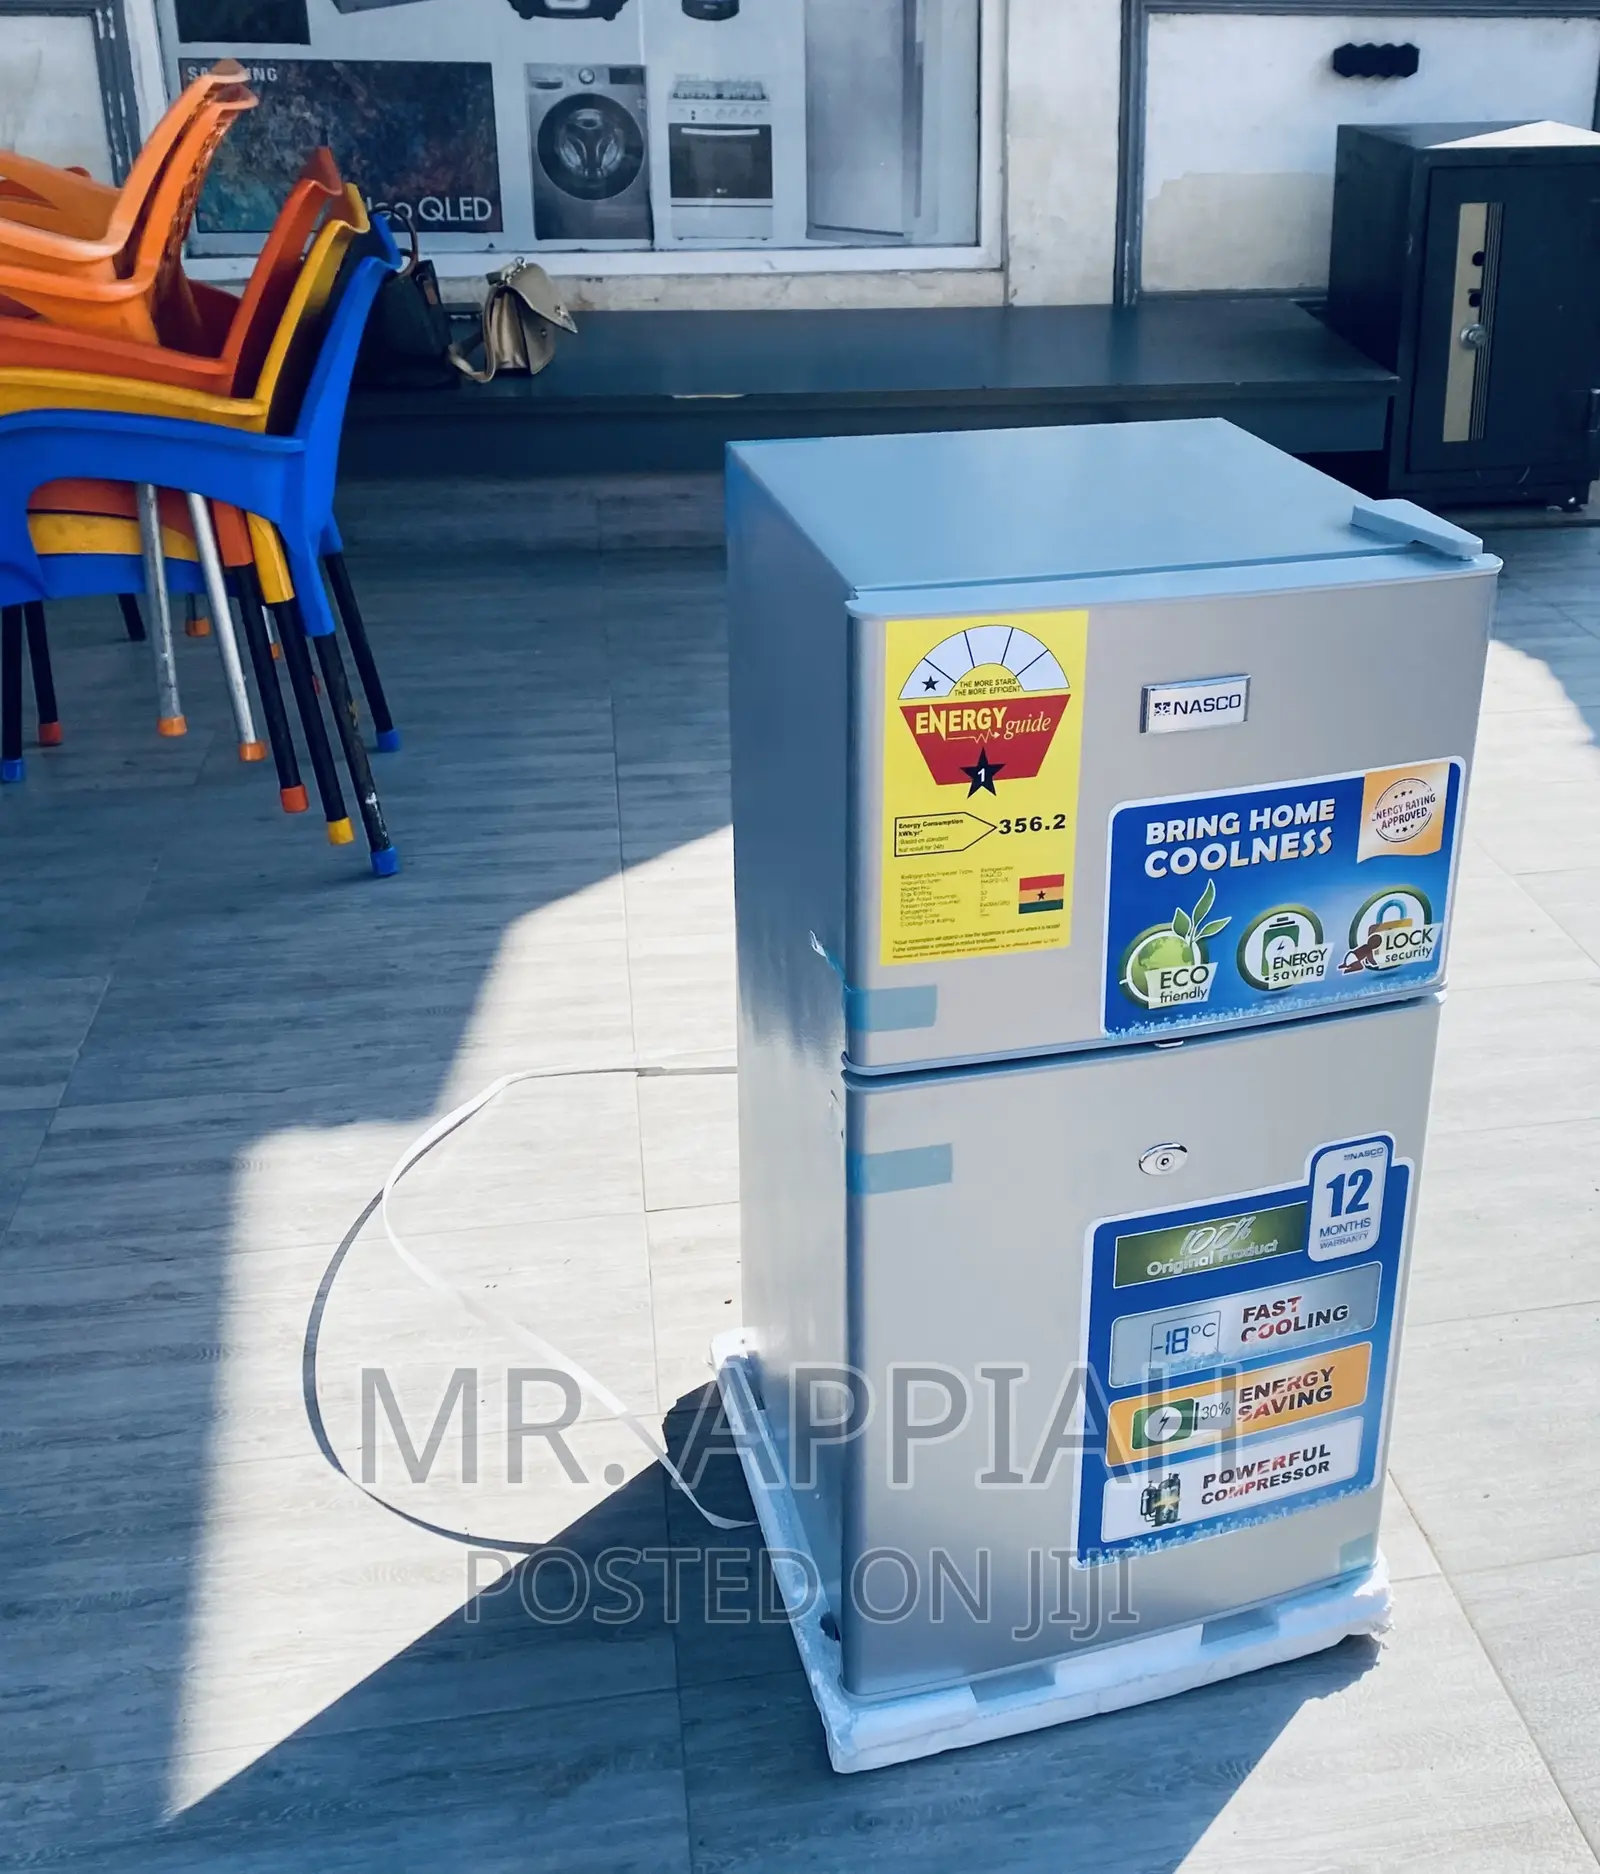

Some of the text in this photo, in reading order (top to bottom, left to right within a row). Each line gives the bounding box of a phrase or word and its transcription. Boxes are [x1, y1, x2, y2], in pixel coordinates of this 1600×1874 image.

[418, 196, 493, 222] QLED
[954, 685, 1021, 696] THE MORE EFFICIENT
[959, 677, 1017, 688] THE MORE STARS
[1174, 694, 1242, 716] NASCO
[916, 705, 1051, 741] ENERGY guide
[977, 768, 986, 783] 1
[1405, 792, 1436, 811] RATING
[998, 814, 1067, 834] 356.2
[1145, 798, 1336, 845] BRING HOME
[1381, 806, 1428, 830] APPROVED
[1144, 826, 1334, 879] COOLNESS
[1385, 929, 1434, 951] LOCK
[1272, 947, 1329, 970] ENERGY
[1385, 945, 1434, 964] security
[1160, 965, 1210, 990] ECO
[1272, 963, 1326, 983] saving
[1159, 980, 1209, 1005] friendly
[1351, 1147, 1384, 1160] NASCO
[1326, 1168, 1373, 1218] 12
[1320, 1217, 1372, 1238] MONTHS
[1146, 1239, 1279, 1276] Original Product
[1242, 1296, 1302, 1324] FAST
[1240, 1304, 1350, 1343] COOLING
[1238, 1365, 1336, 1404] ENERGY
[1200, 1400, 1231, 1421] 30%
[1237, 1384, 1333, 1422] SAVING
[1203, 1443, 1331, 1490] POWERFUL
[1201, 1460, 1331, 1505] COMPRESSOR
